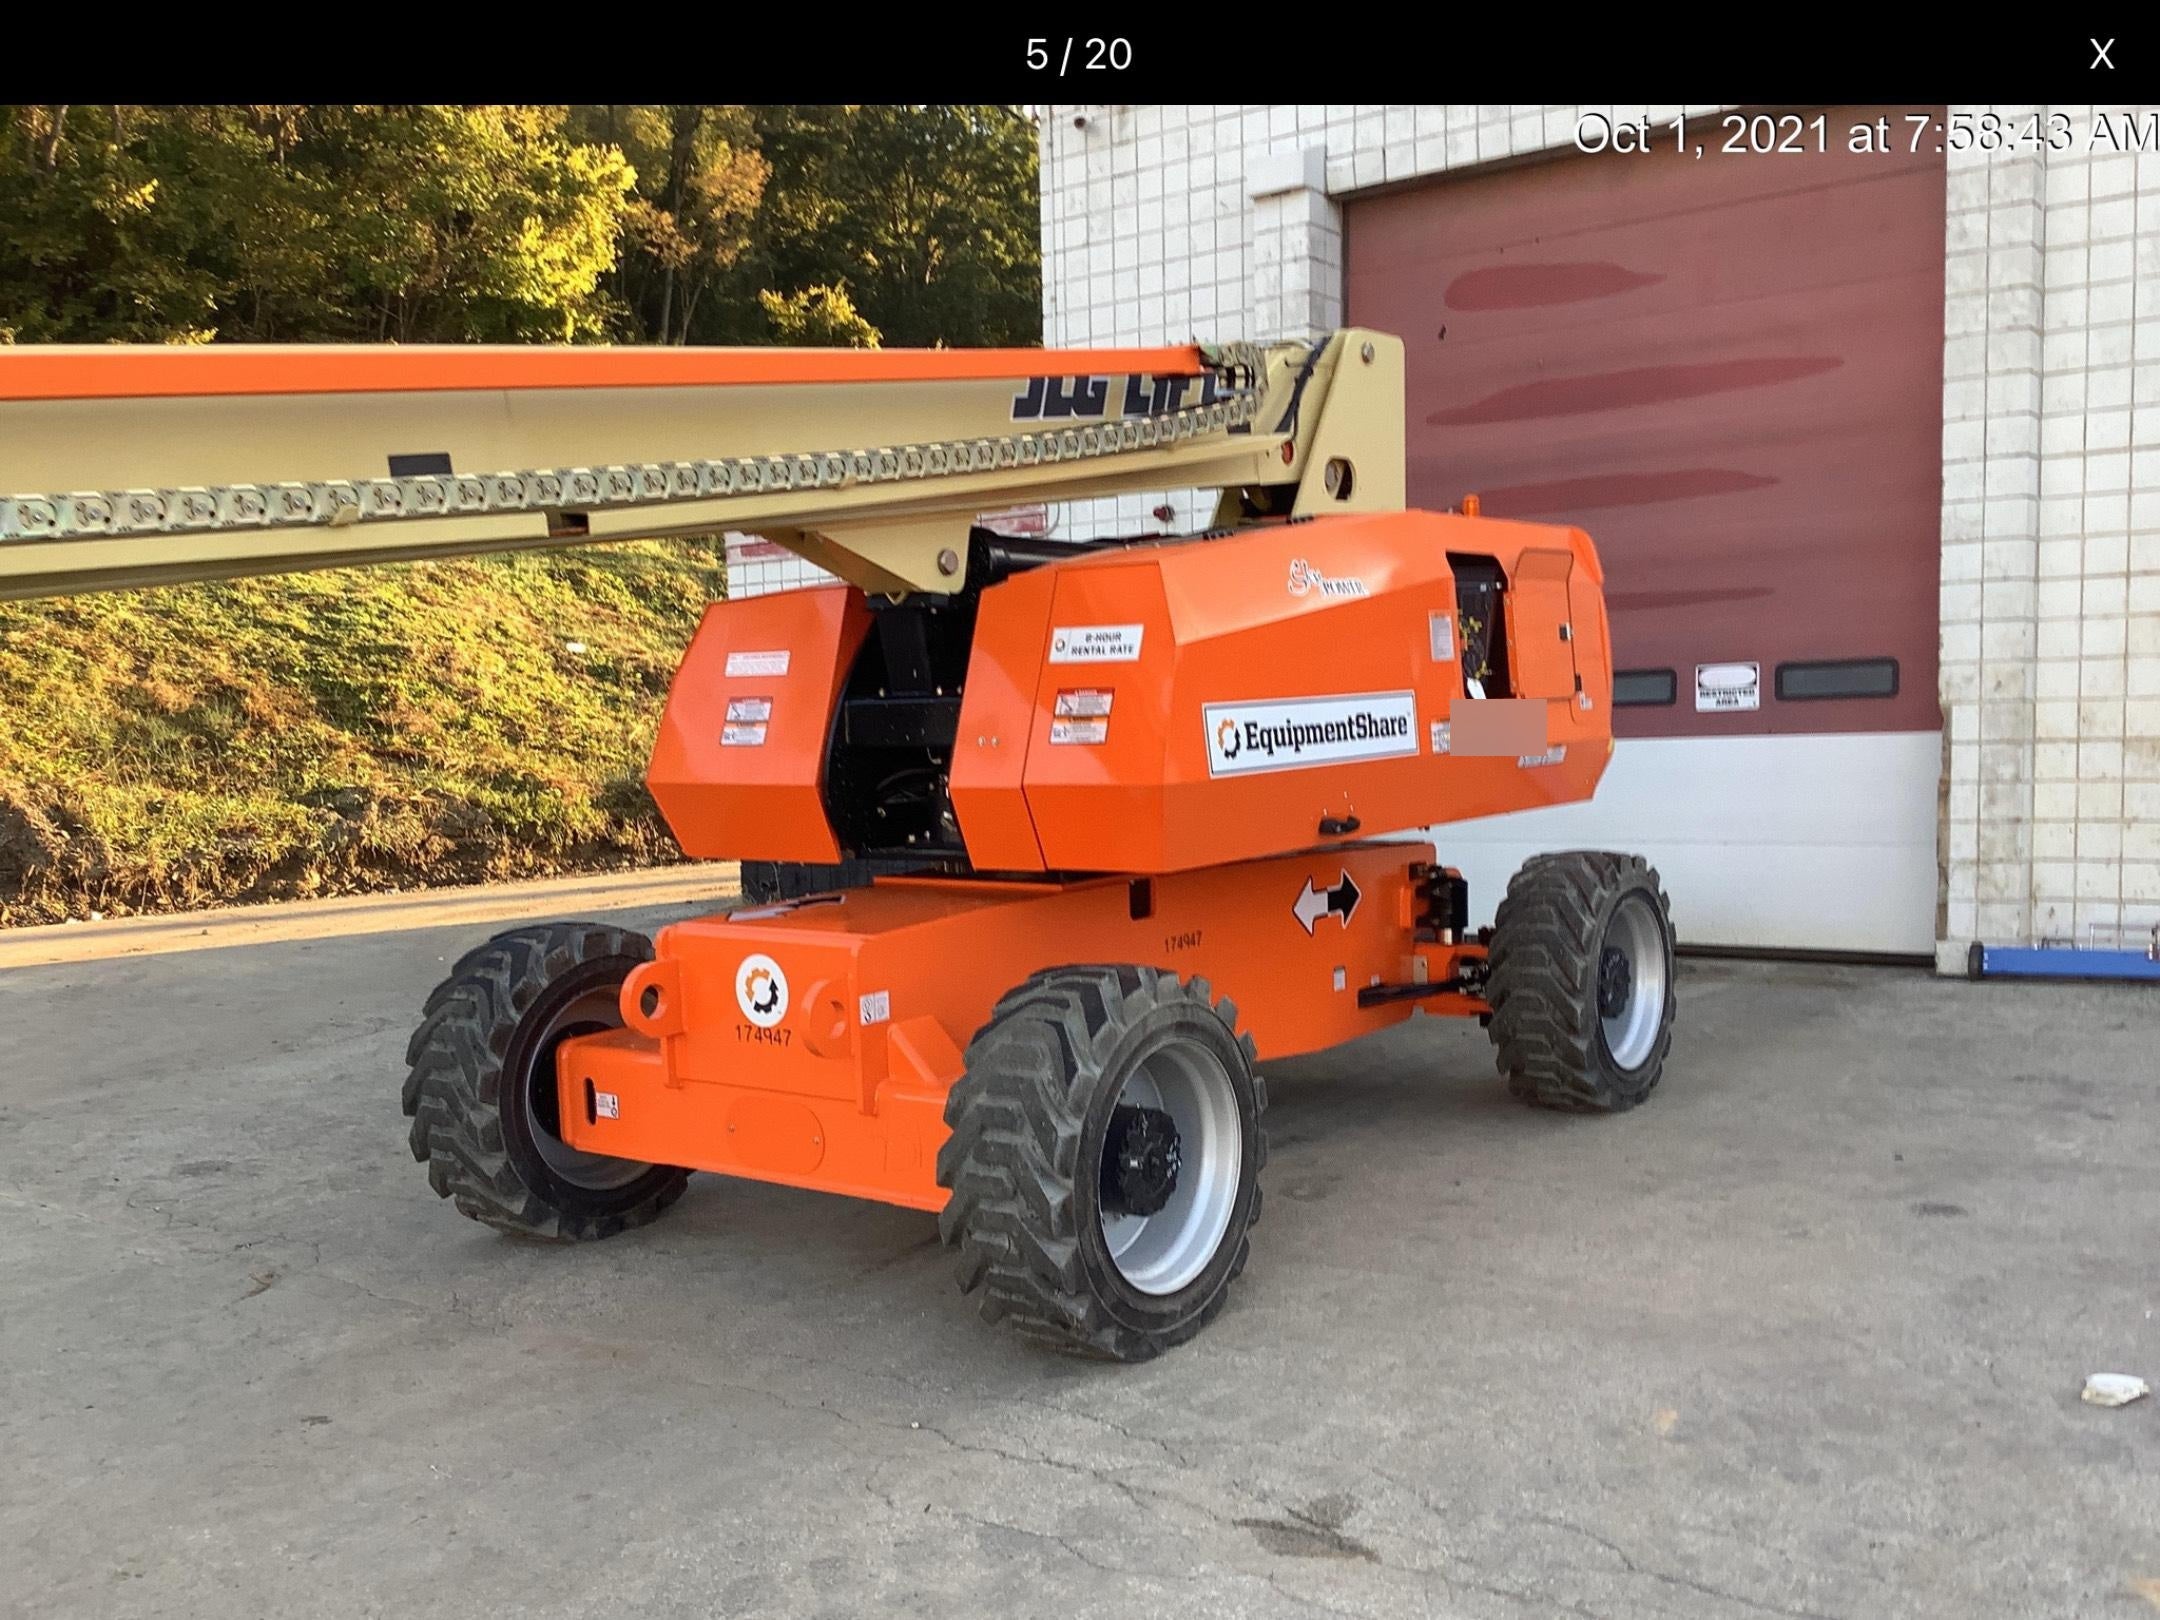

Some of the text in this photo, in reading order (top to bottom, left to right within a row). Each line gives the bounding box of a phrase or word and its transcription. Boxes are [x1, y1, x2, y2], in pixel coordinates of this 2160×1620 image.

[1071, 643, 1134, 656] RENTAL RATE
[1244, 711, 1408, 757] EquipmentShare
[1165, 930, 1202, 953] 174947
[735, 1023, 791, 1047] 174947
